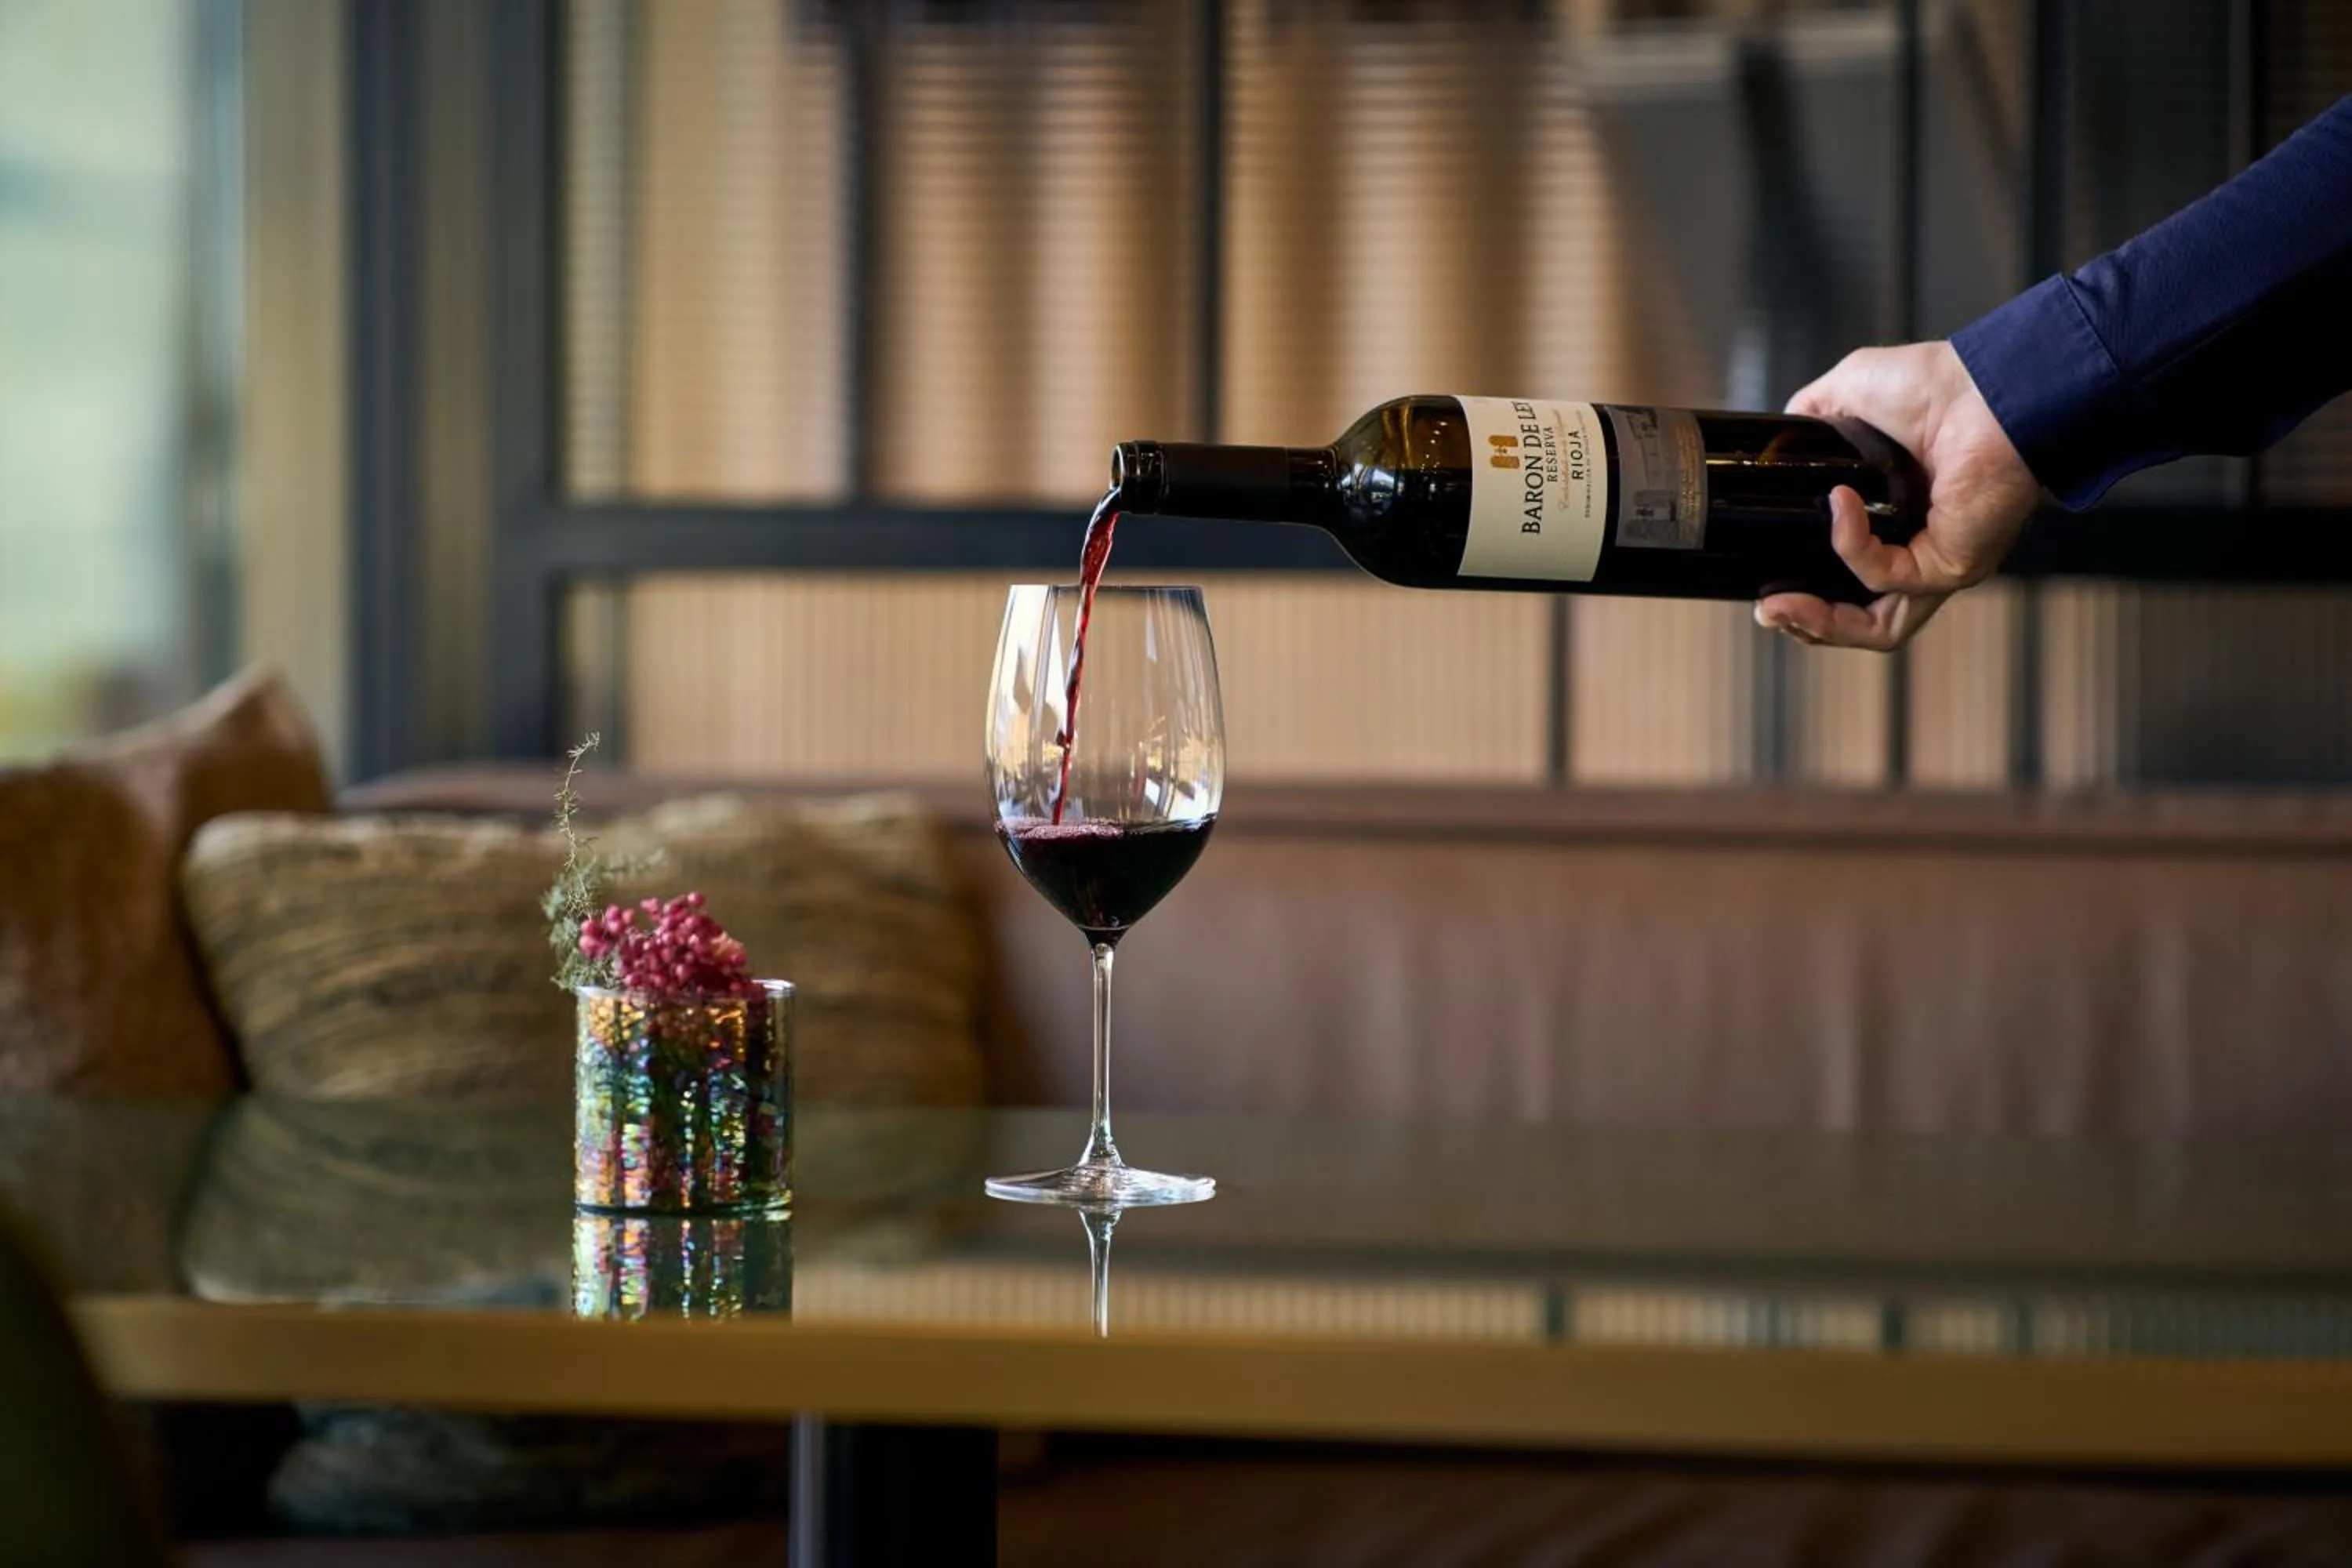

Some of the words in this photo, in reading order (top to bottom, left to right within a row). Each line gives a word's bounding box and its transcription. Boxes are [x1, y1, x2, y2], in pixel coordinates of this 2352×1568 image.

[1520, 423, 1542, 449] DE
[1543, 426, 1559, 483] RESERVA
[1568, 430, 1584, 481] RIOJA
[1521, 455, 1544, 534] BARON
